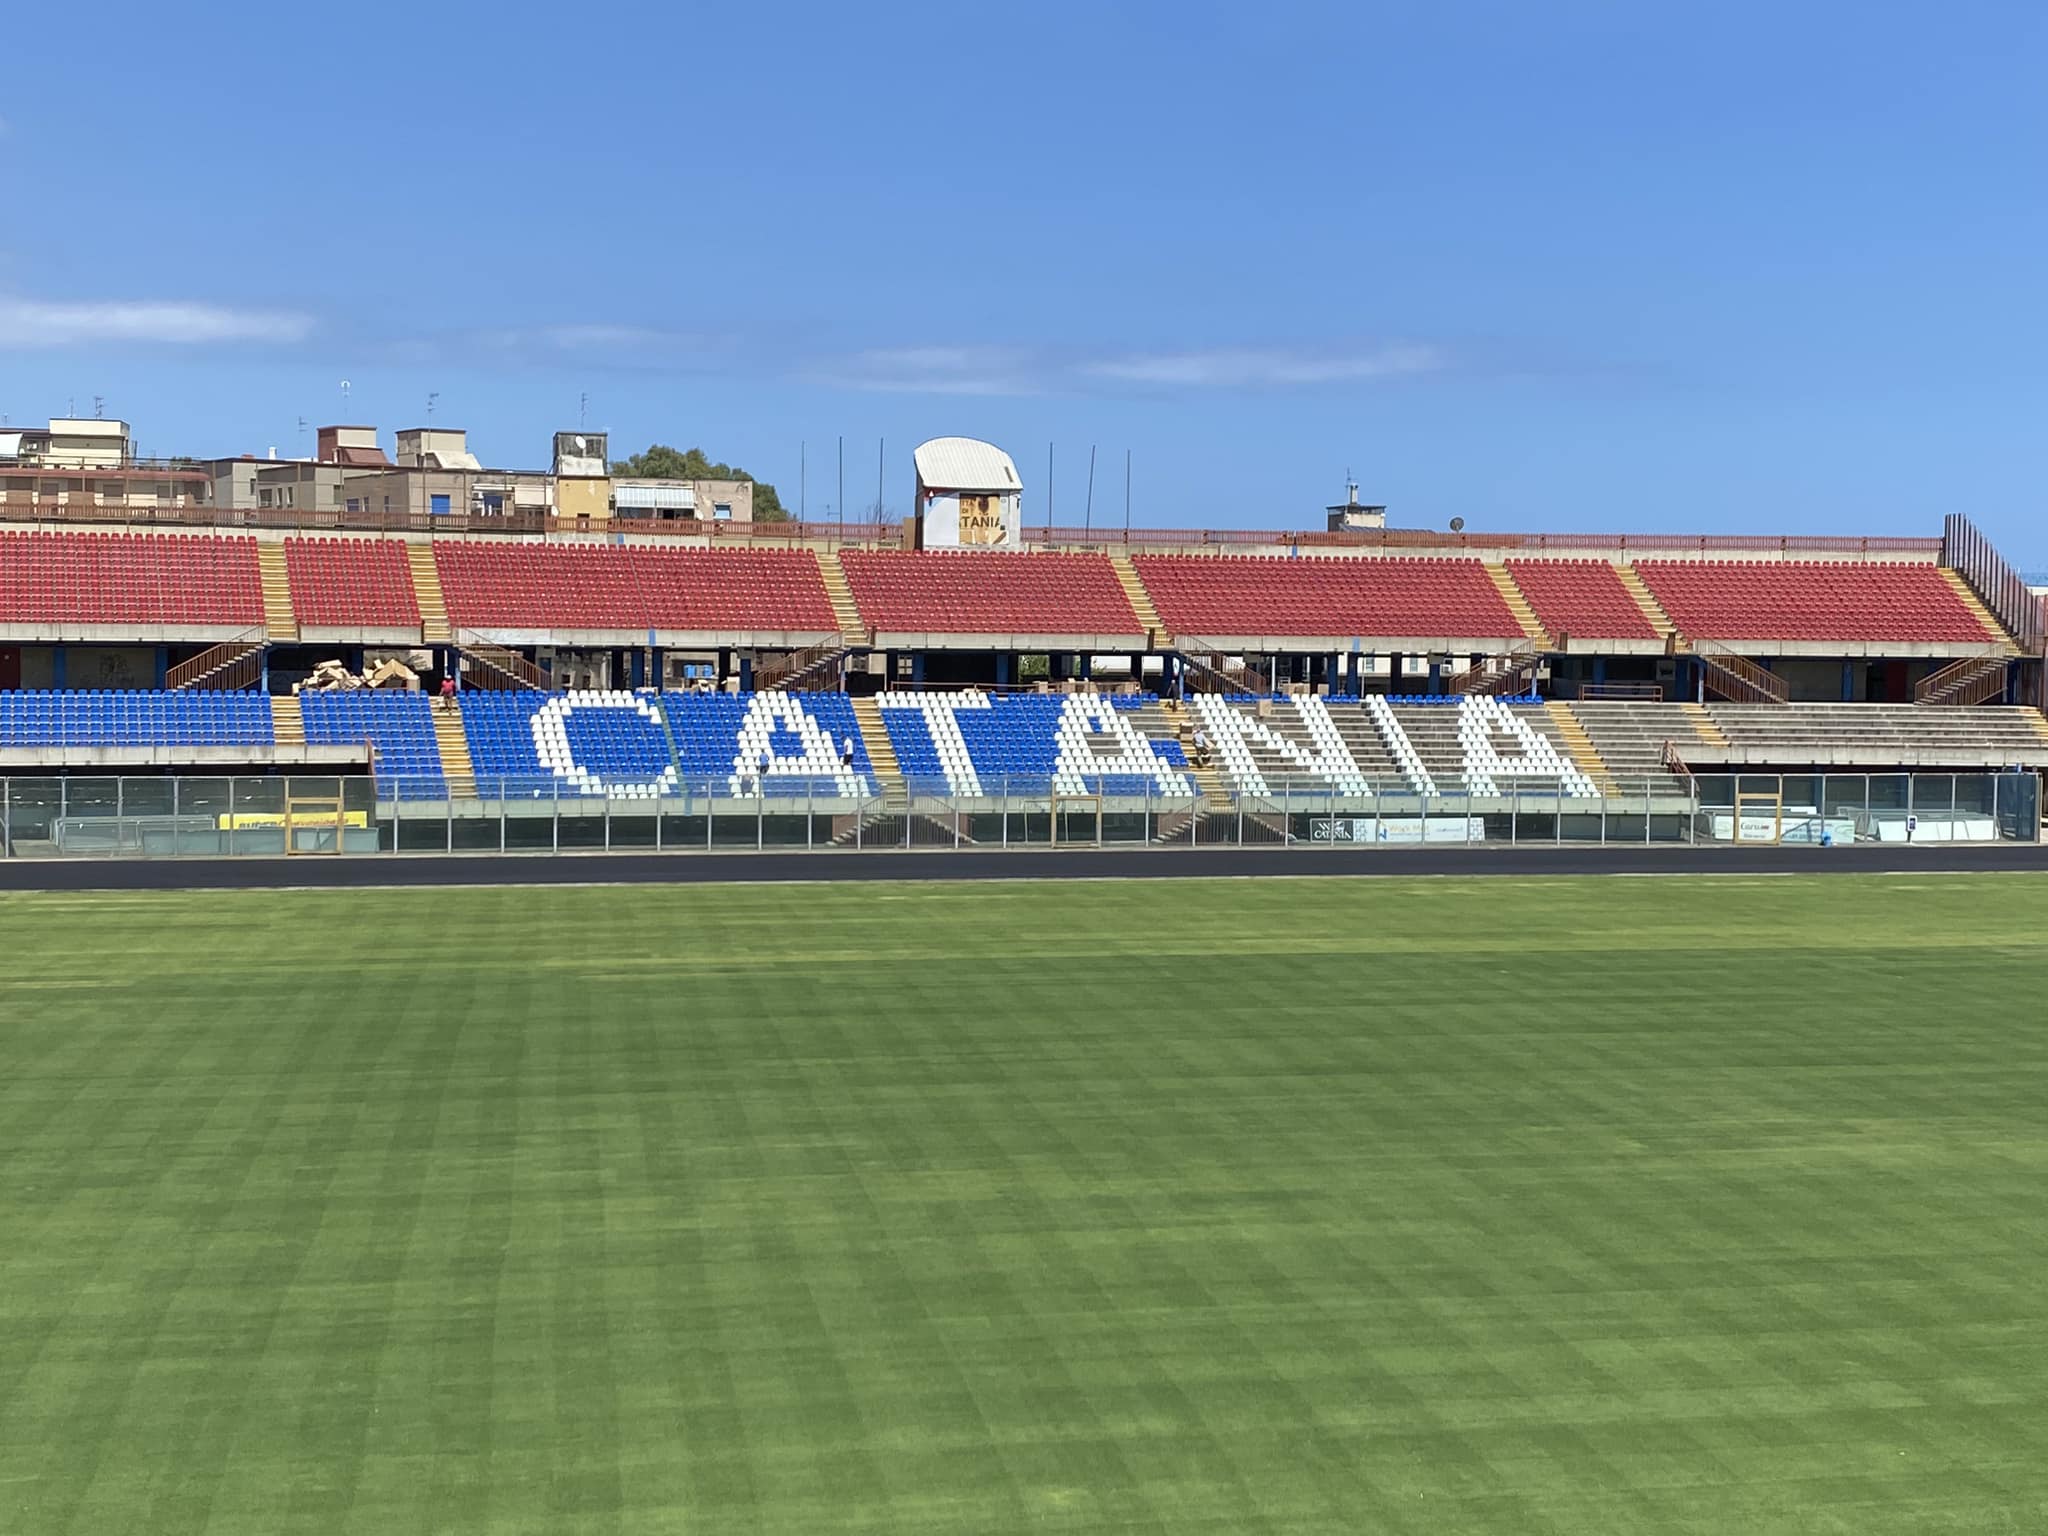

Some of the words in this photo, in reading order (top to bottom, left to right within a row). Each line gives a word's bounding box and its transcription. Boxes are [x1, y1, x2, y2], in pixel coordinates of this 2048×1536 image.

[959, 516, 1000, 528] TANIA
[530, 690, 1602, 799] CATANIA
[1314, 829, 1352, 840] CATNIA
